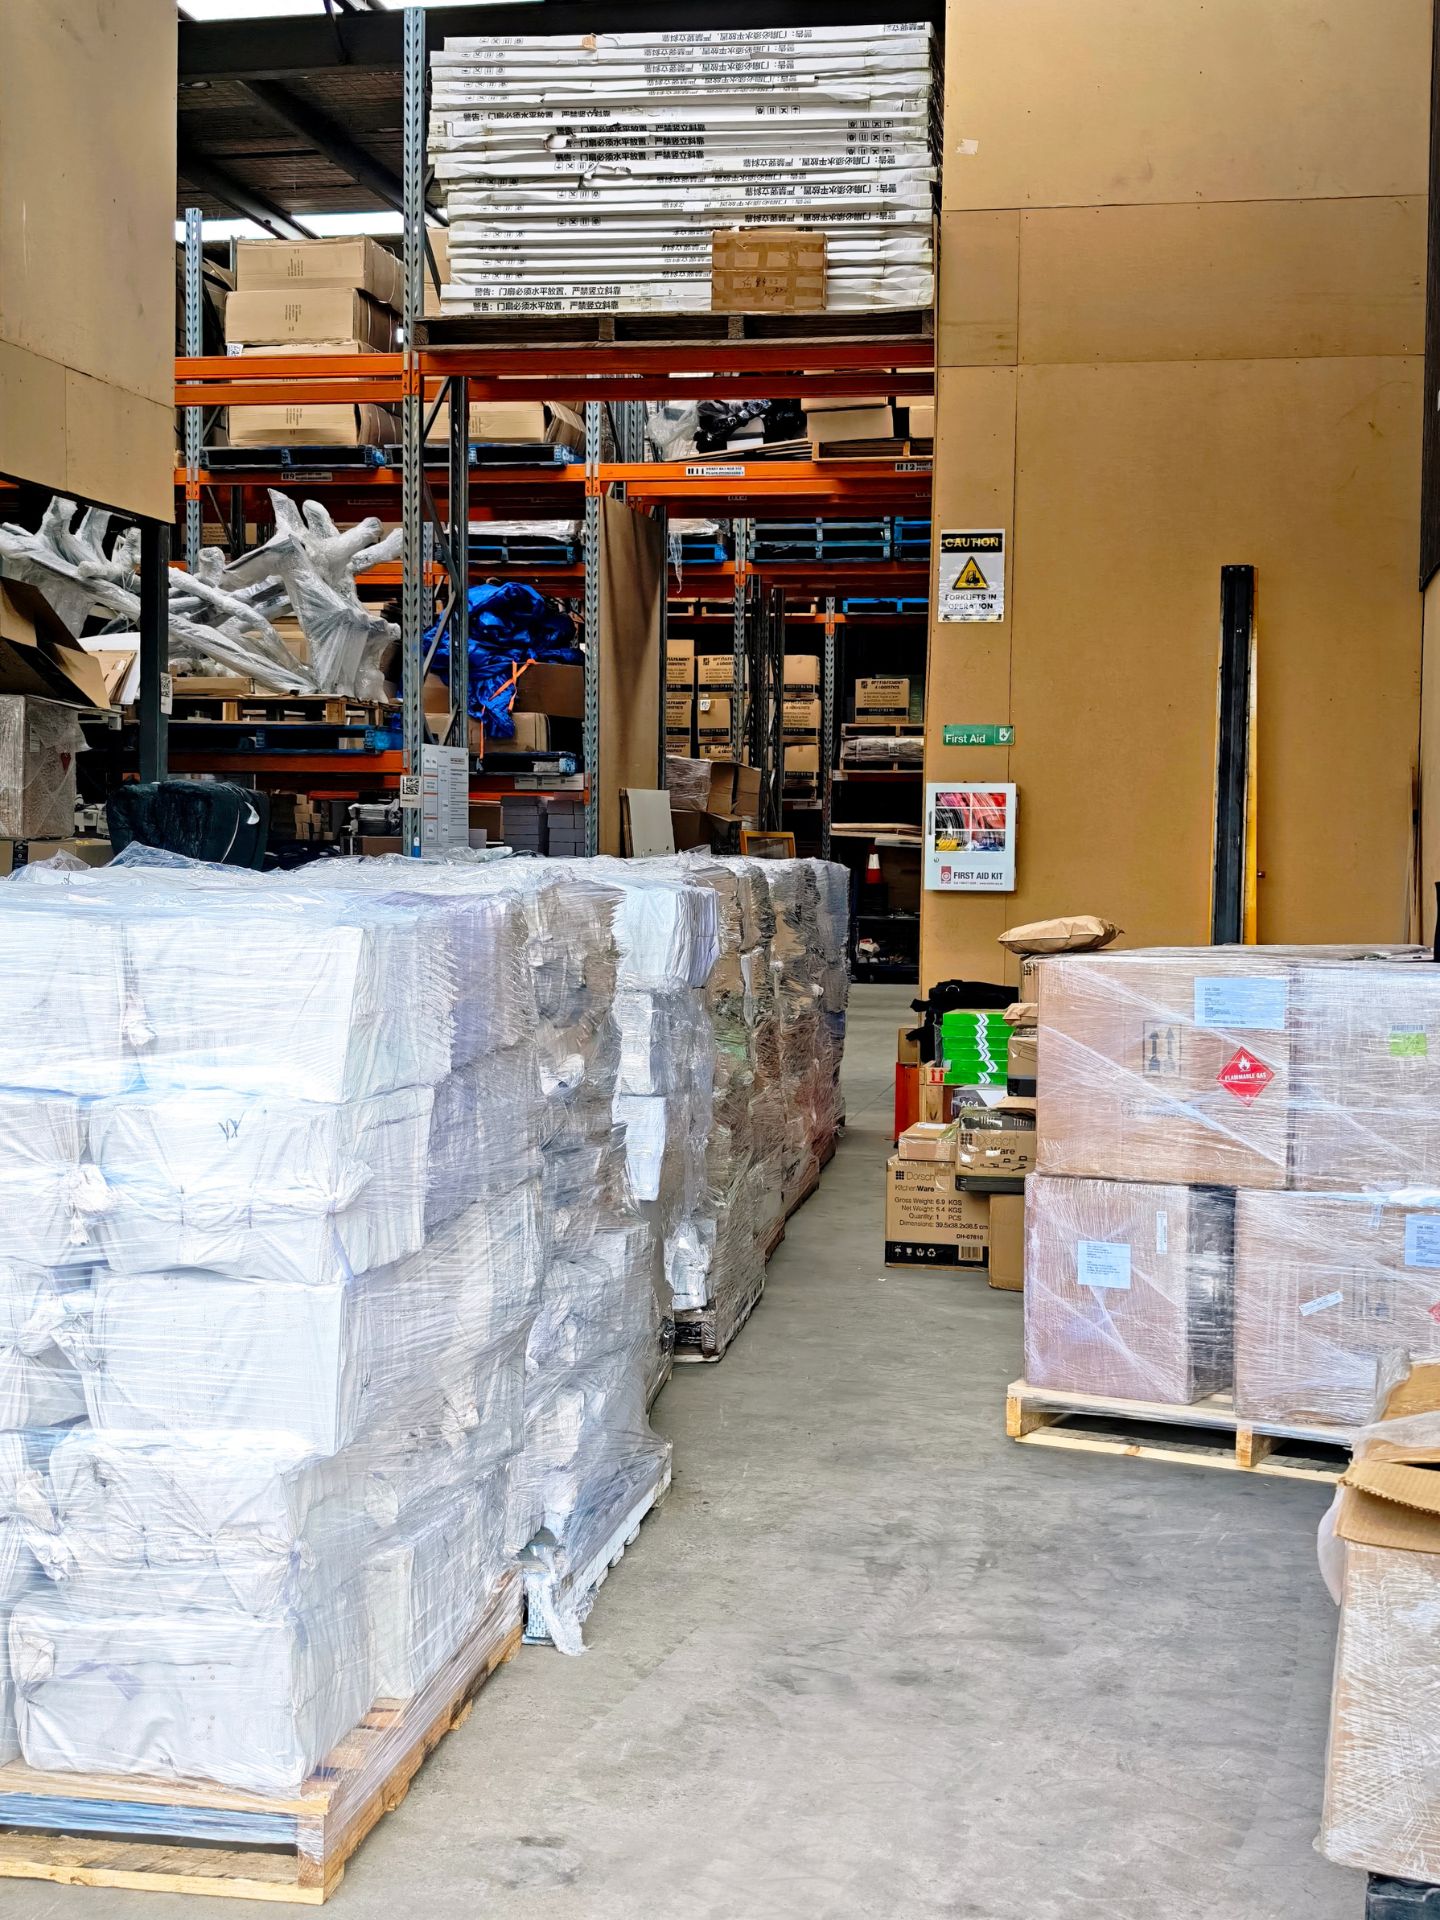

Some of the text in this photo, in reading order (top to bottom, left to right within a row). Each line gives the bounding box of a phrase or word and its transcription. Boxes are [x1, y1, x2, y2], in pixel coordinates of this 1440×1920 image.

[945, 537, 999, 548] CAUTION
[945, 593, 986, 601] FORKLIFTS
[948, 602, 993, 610] OPERATION
[945, 733, 986, 743] First Aid
[953, 871, 1004, 880] FIRST AID KIT
[906, 1171, 936, 1181] Dorsch
[894, 1196, 912, 1204] Gross
[913, 1198, 934, 1206] Weight:
[912, 1205, 935, 1213] Weight:
[899, 1219, 935, 1227] Dimensions:
